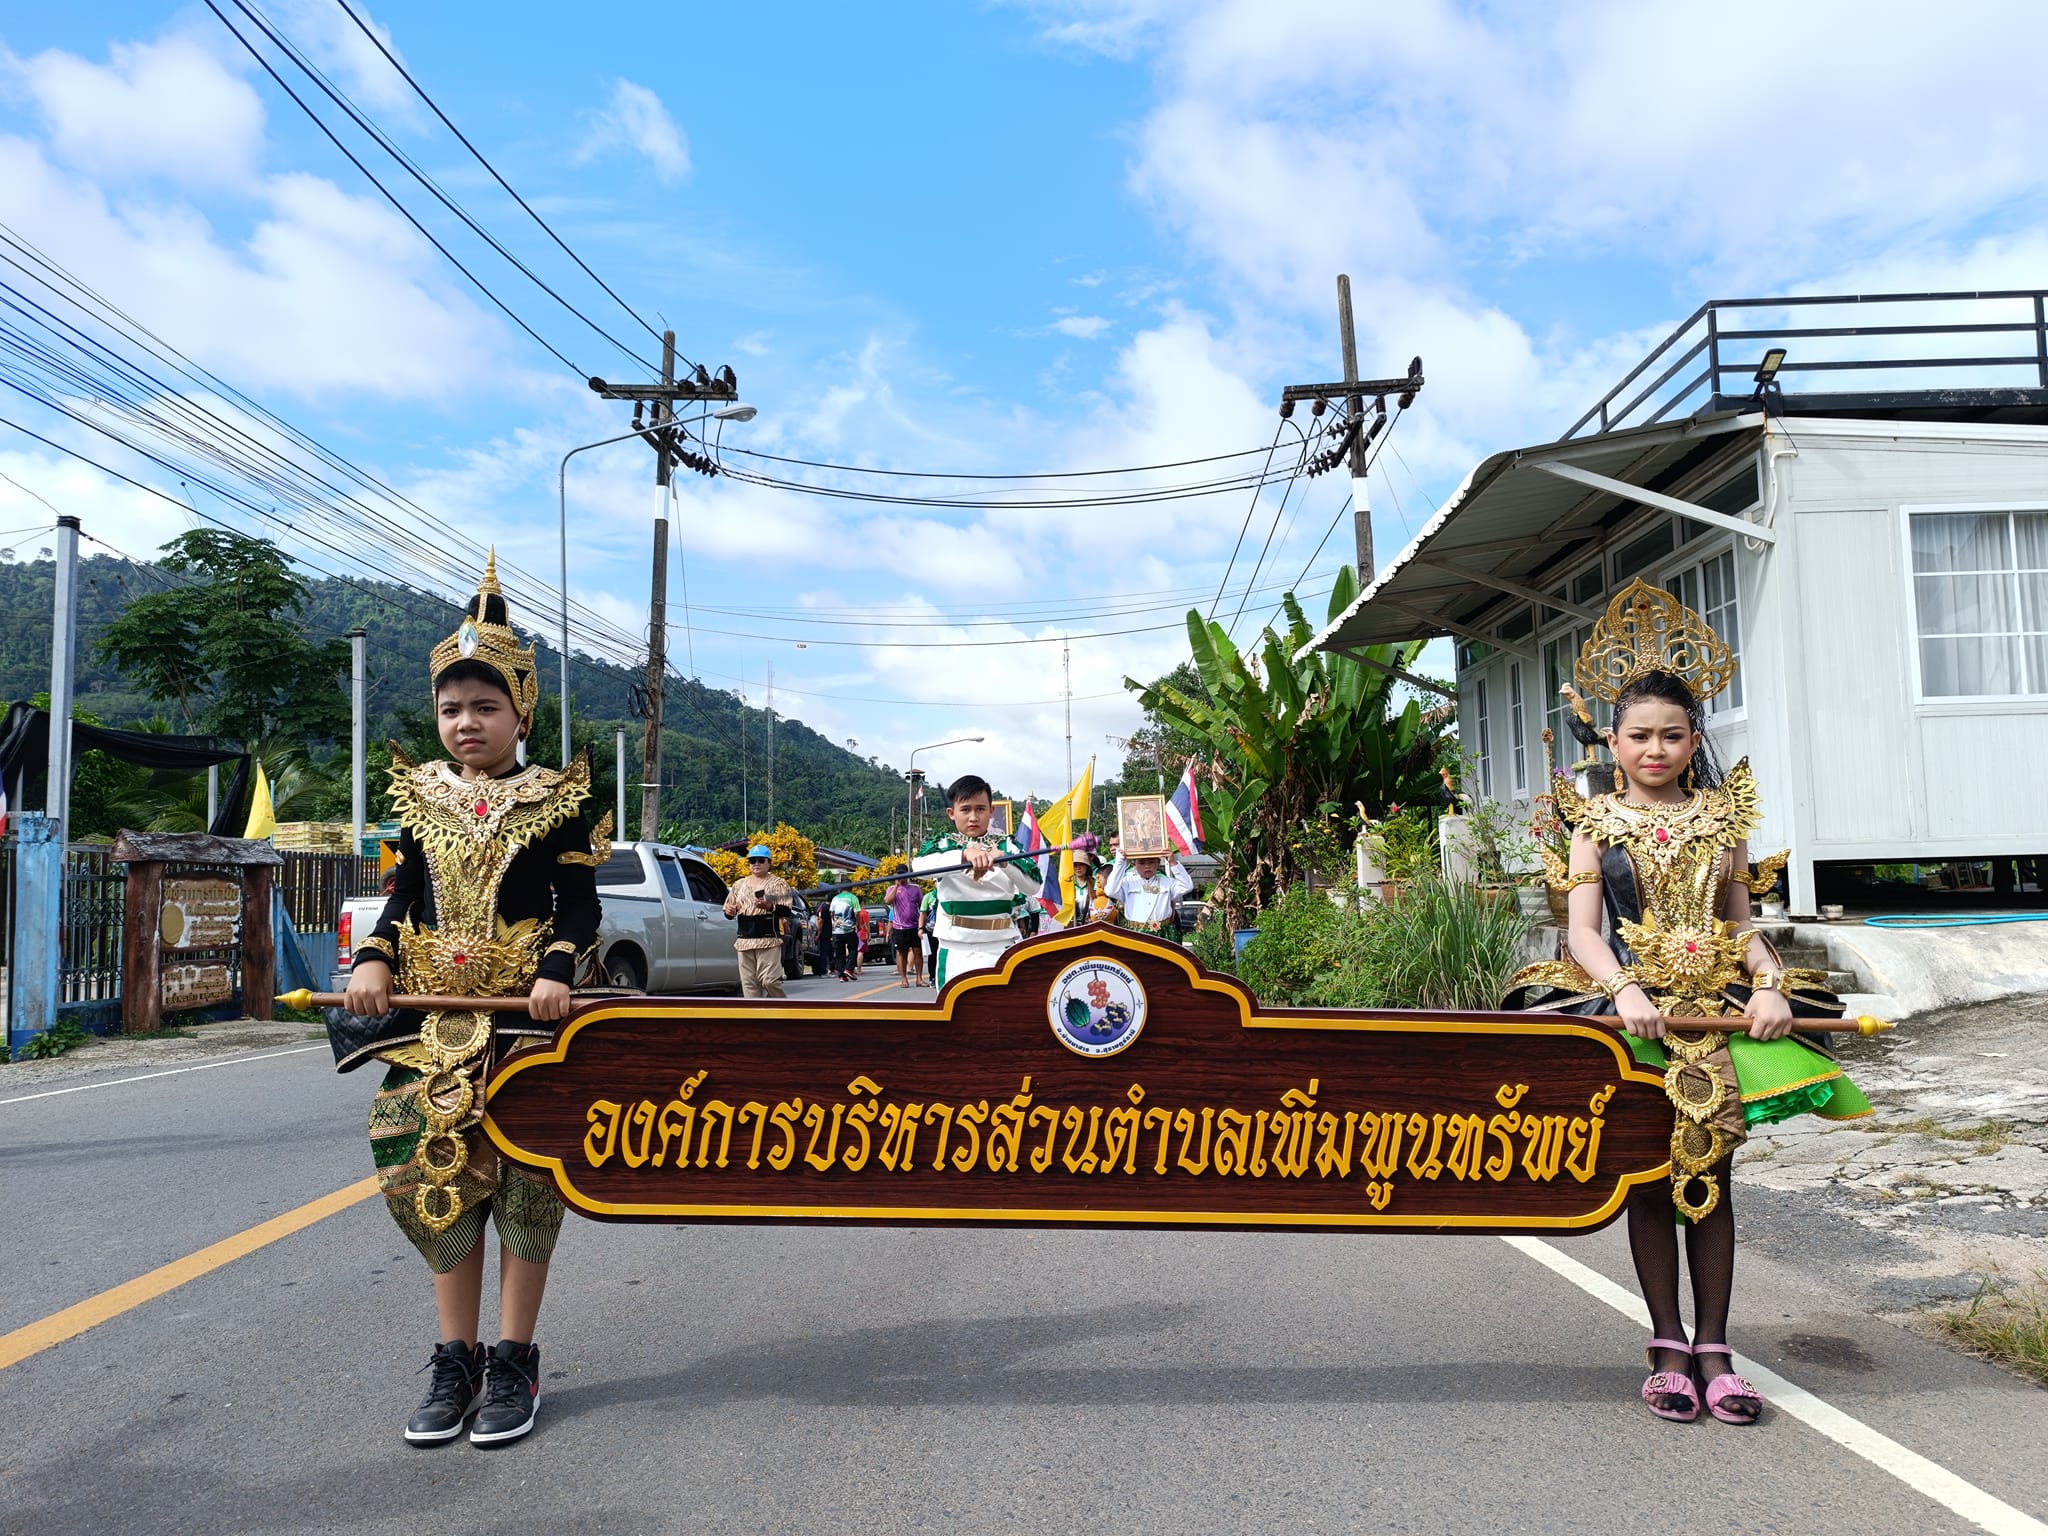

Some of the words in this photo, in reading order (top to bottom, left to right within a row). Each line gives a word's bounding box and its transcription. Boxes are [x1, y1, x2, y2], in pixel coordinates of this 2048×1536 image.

[583, 1070, 1616, 1211] องค์การบริหารส่วนตำบลเพิ่มพูนทรัพย์
